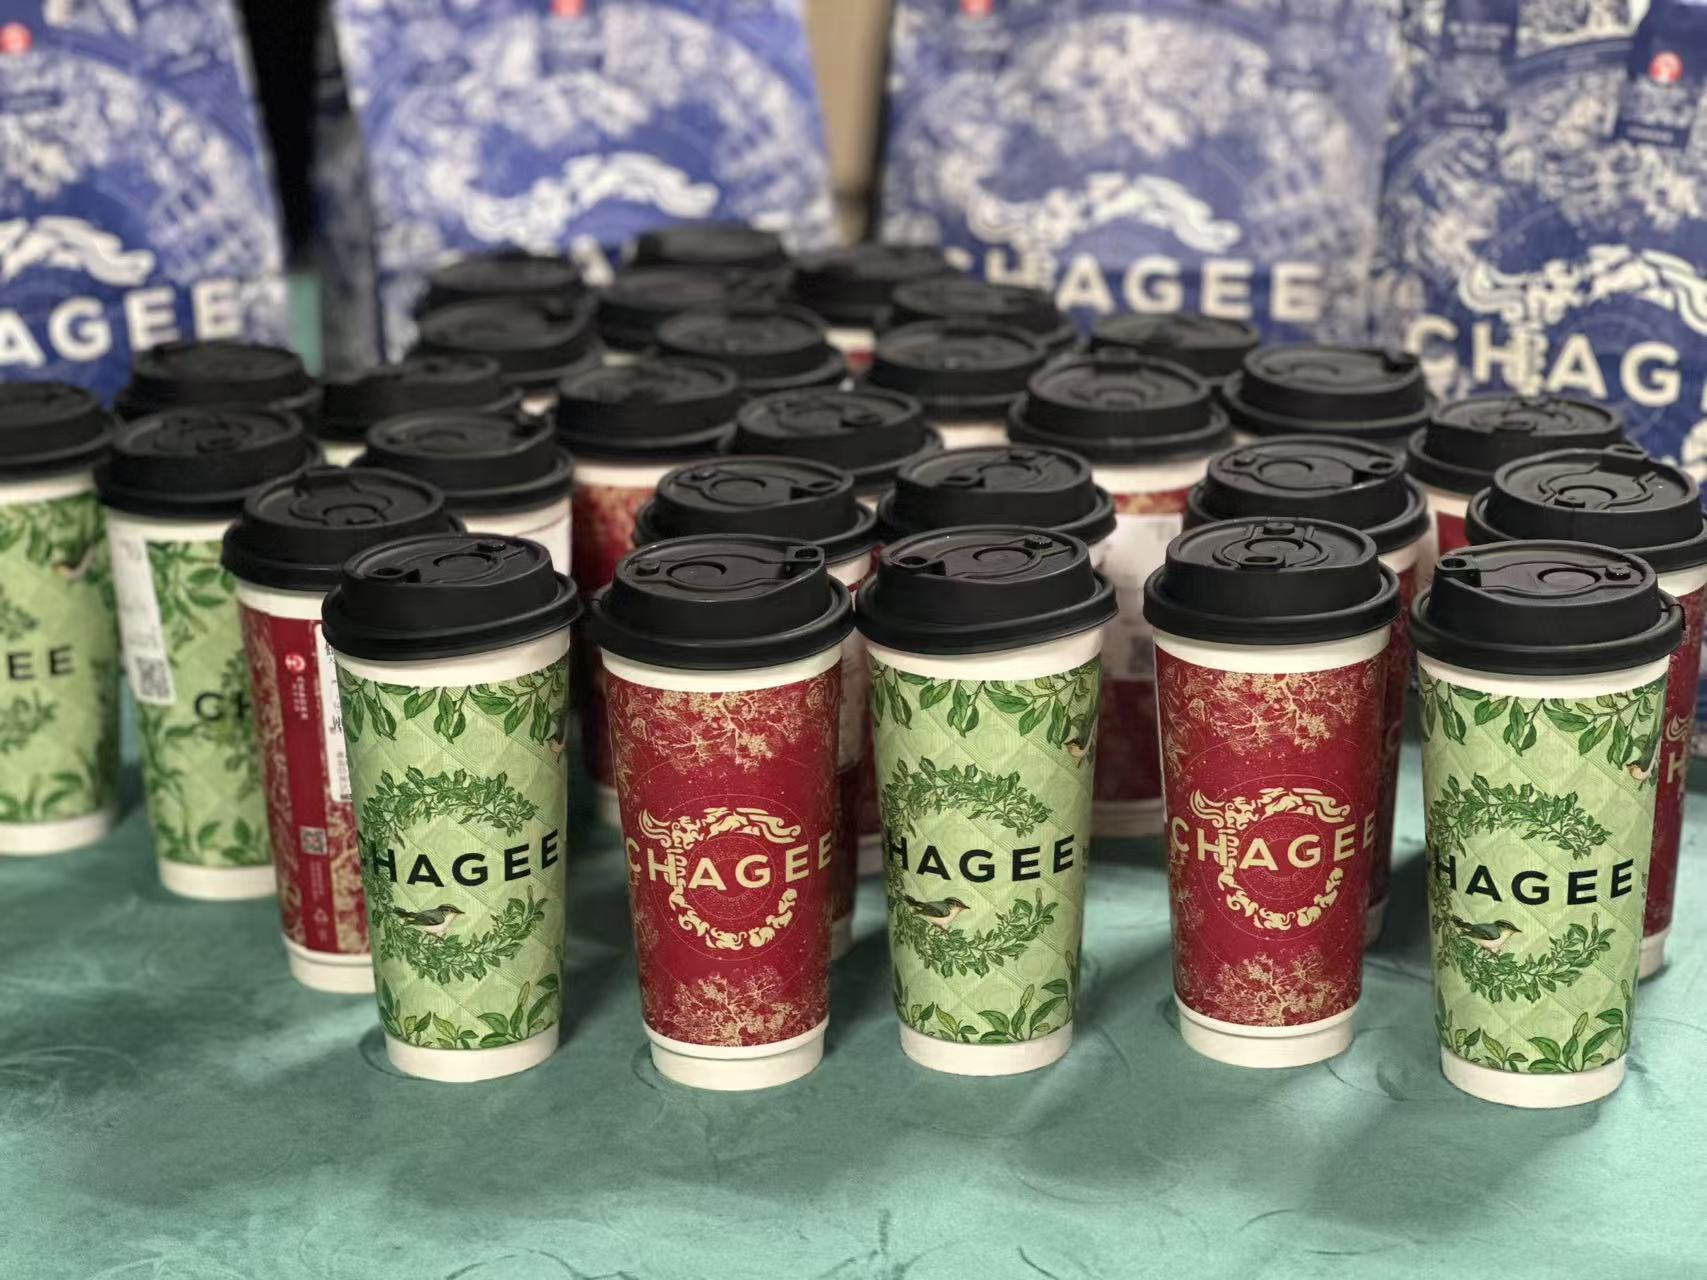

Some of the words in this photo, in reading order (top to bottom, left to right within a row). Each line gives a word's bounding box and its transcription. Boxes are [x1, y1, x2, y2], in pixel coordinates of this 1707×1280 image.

[945, 247, 1325, 322] HAGEE
[1406, 315, 1707, 414] CHAG
[357, 828, 559, 888] HAGEE
[625, 831, 833, 891] CHAGEE
[1171, 809, 1377, 871] CHAGEE
